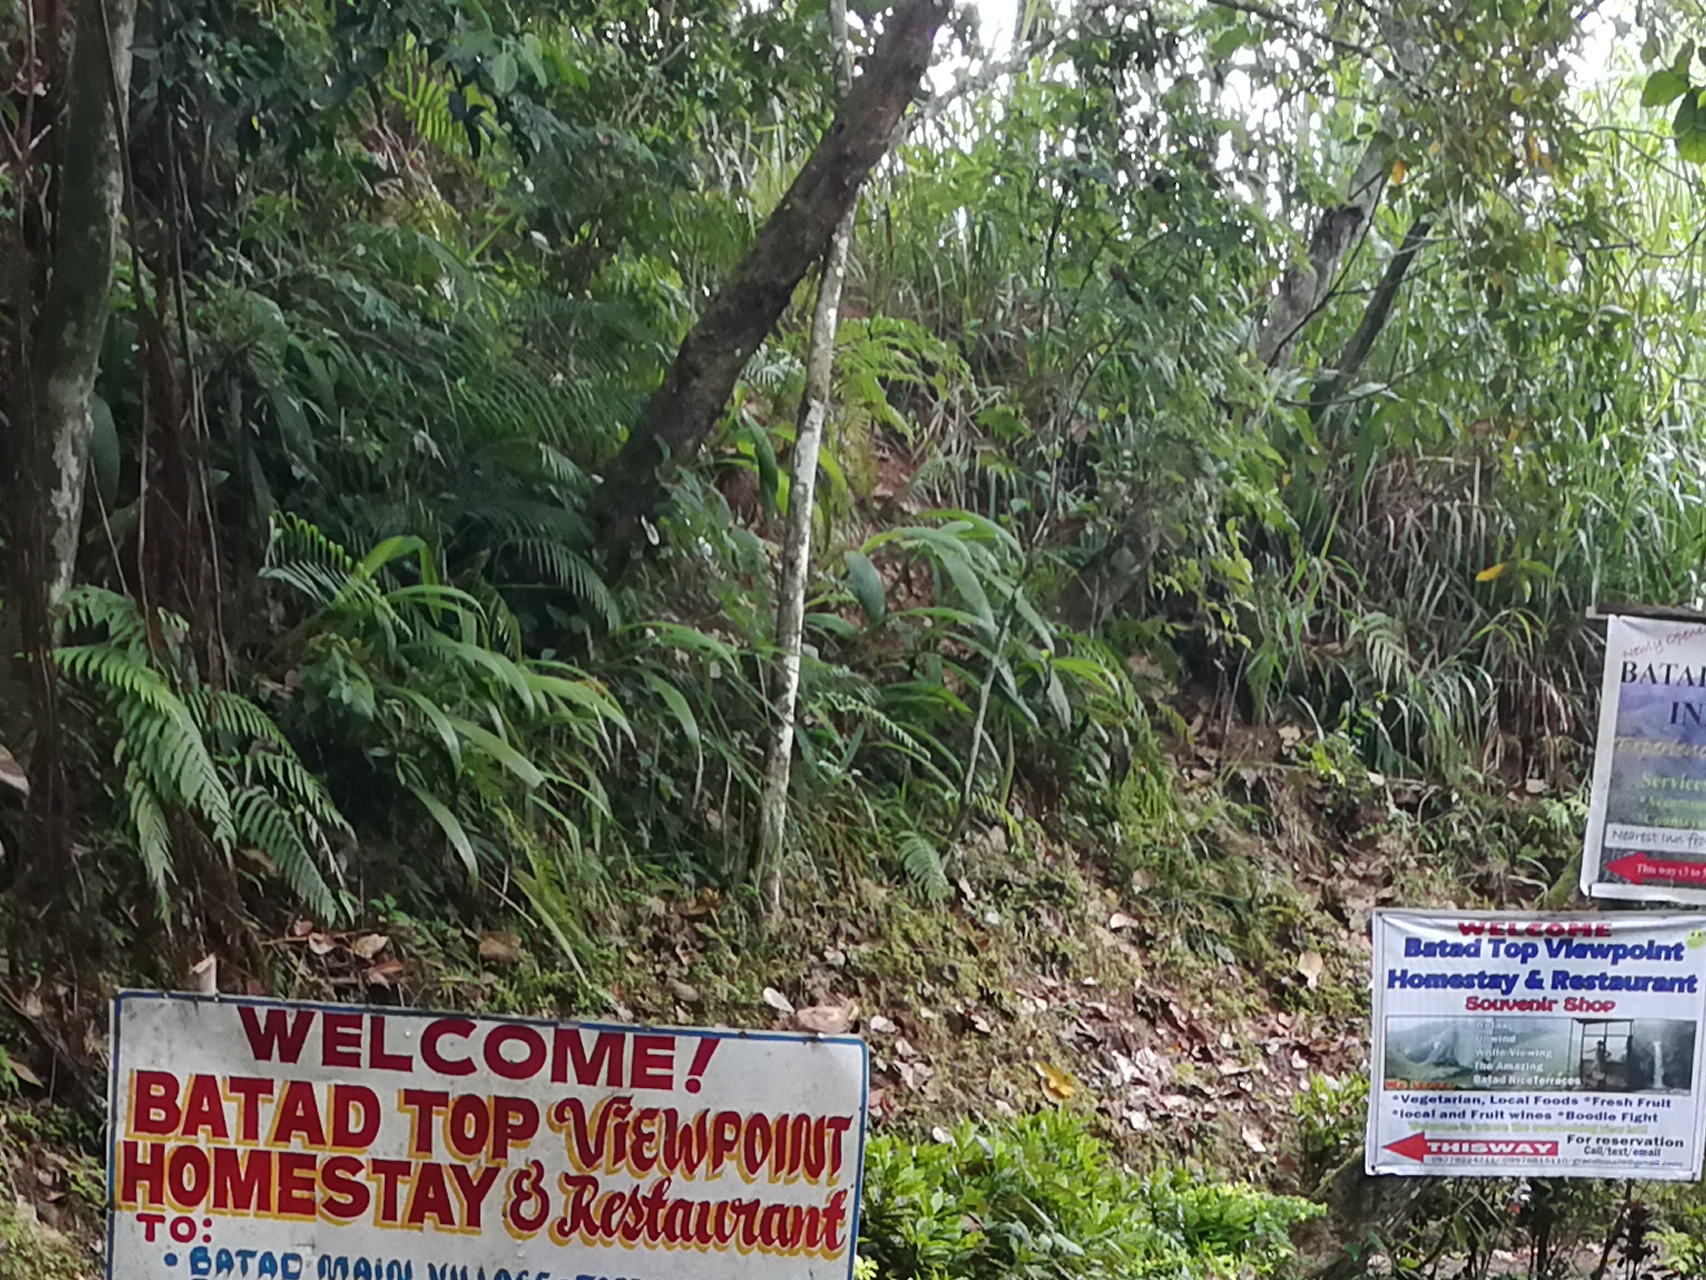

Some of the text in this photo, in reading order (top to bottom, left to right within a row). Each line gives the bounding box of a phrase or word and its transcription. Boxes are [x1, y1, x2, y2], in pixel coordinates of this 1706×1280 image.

[1458, 922, 1612, 937] WELCOME
[1404, 937, 1685, 965] Batad Top Viewpoint
[1387, 969, 1698, 996] Homestay & Restaurant
[1465, 996, 1616, 1012] Souvenir Shop
[237, 1005, 721, 1094] WELCOME!
[125, 1068, 381, 1154] BATAD
[398, 1088, 540, 1167] TOP
[1566, 1134, 1685, 1147] For reservation
[116, 1140, 848, 1261] HOMESTAY & Restaurant
[136, 1213, 213, 1244] TO:
